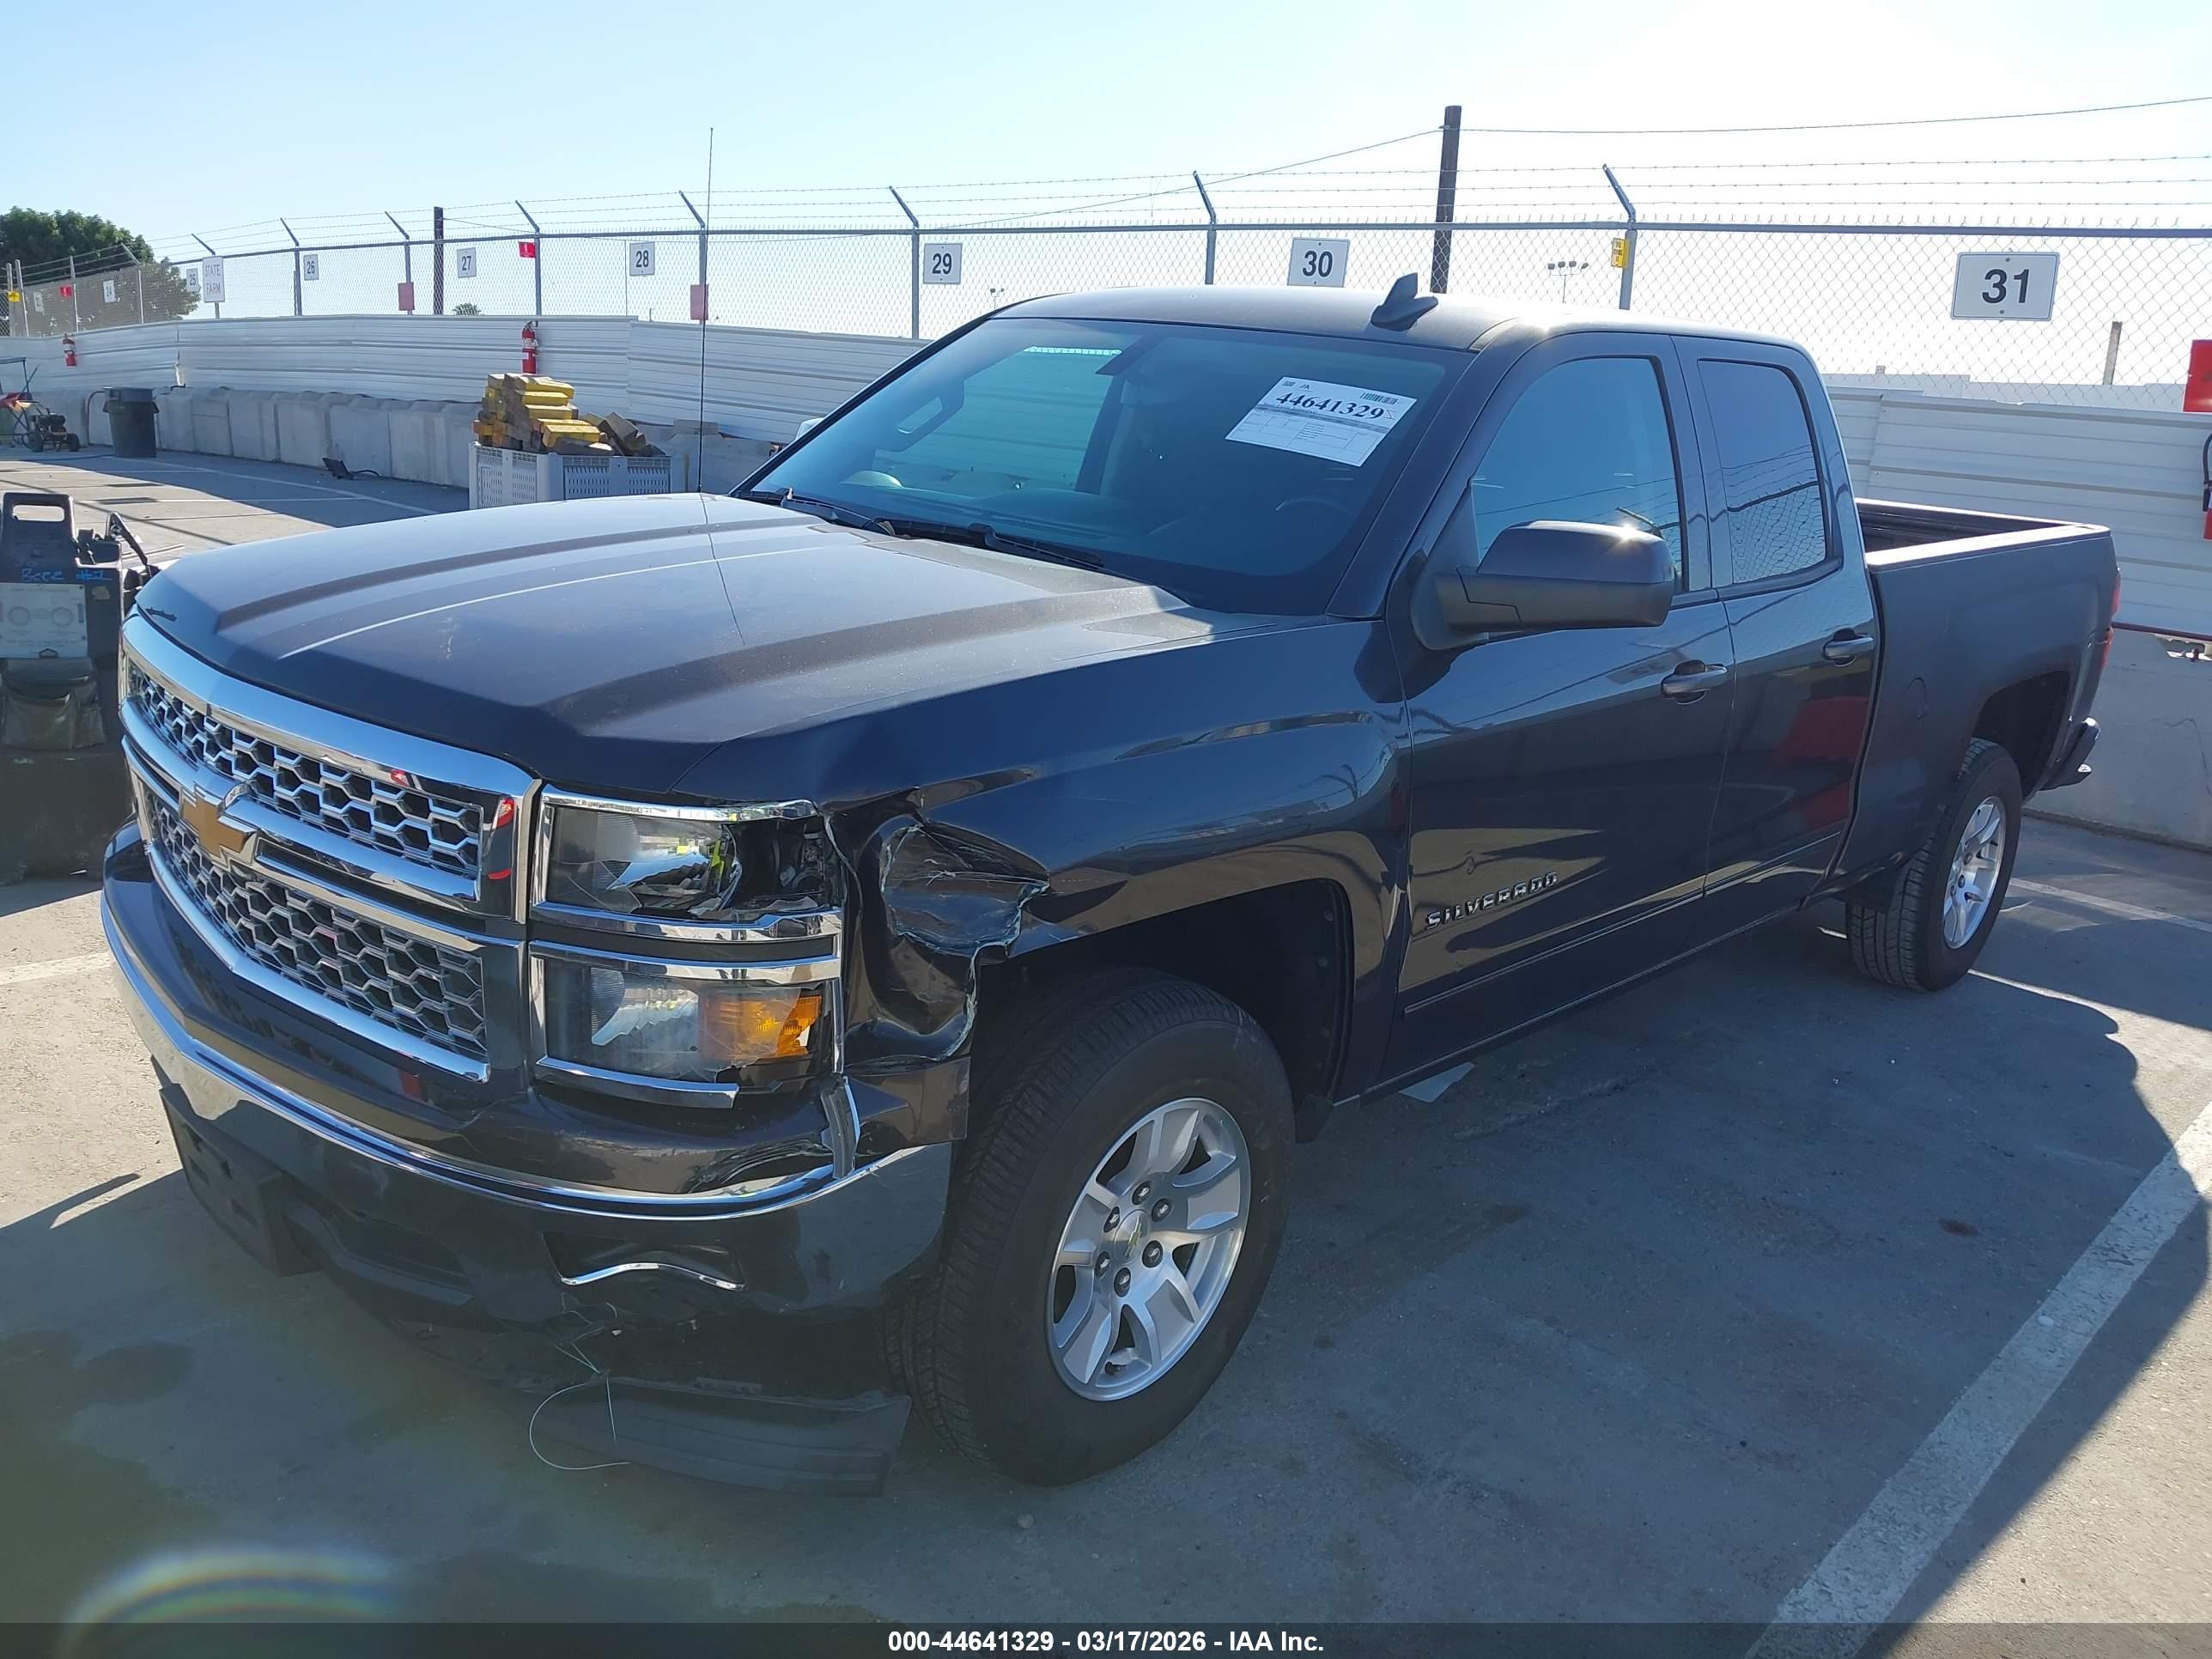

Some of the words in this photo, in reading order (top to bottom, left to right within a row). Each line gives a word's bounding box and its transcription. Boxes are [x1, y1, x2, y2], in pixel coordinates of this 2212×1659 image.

[307, 260, 315, 275] 26
[461, 255, 472, 271] 27
[635, 250, 649, 268] 28
[932, 252, 952, 275] 29
[1302, 250, 1333, 277] 30
[205, 264, 221, 276] STATE
[189, 274, 197, 286] 25
[206, 283, 222, 295] FARM
[1982, 268, 2030, 304] 31
[1276, 392, 1384, 419] 44641329
[1425, 871, 1560, 930] SILVERADO
